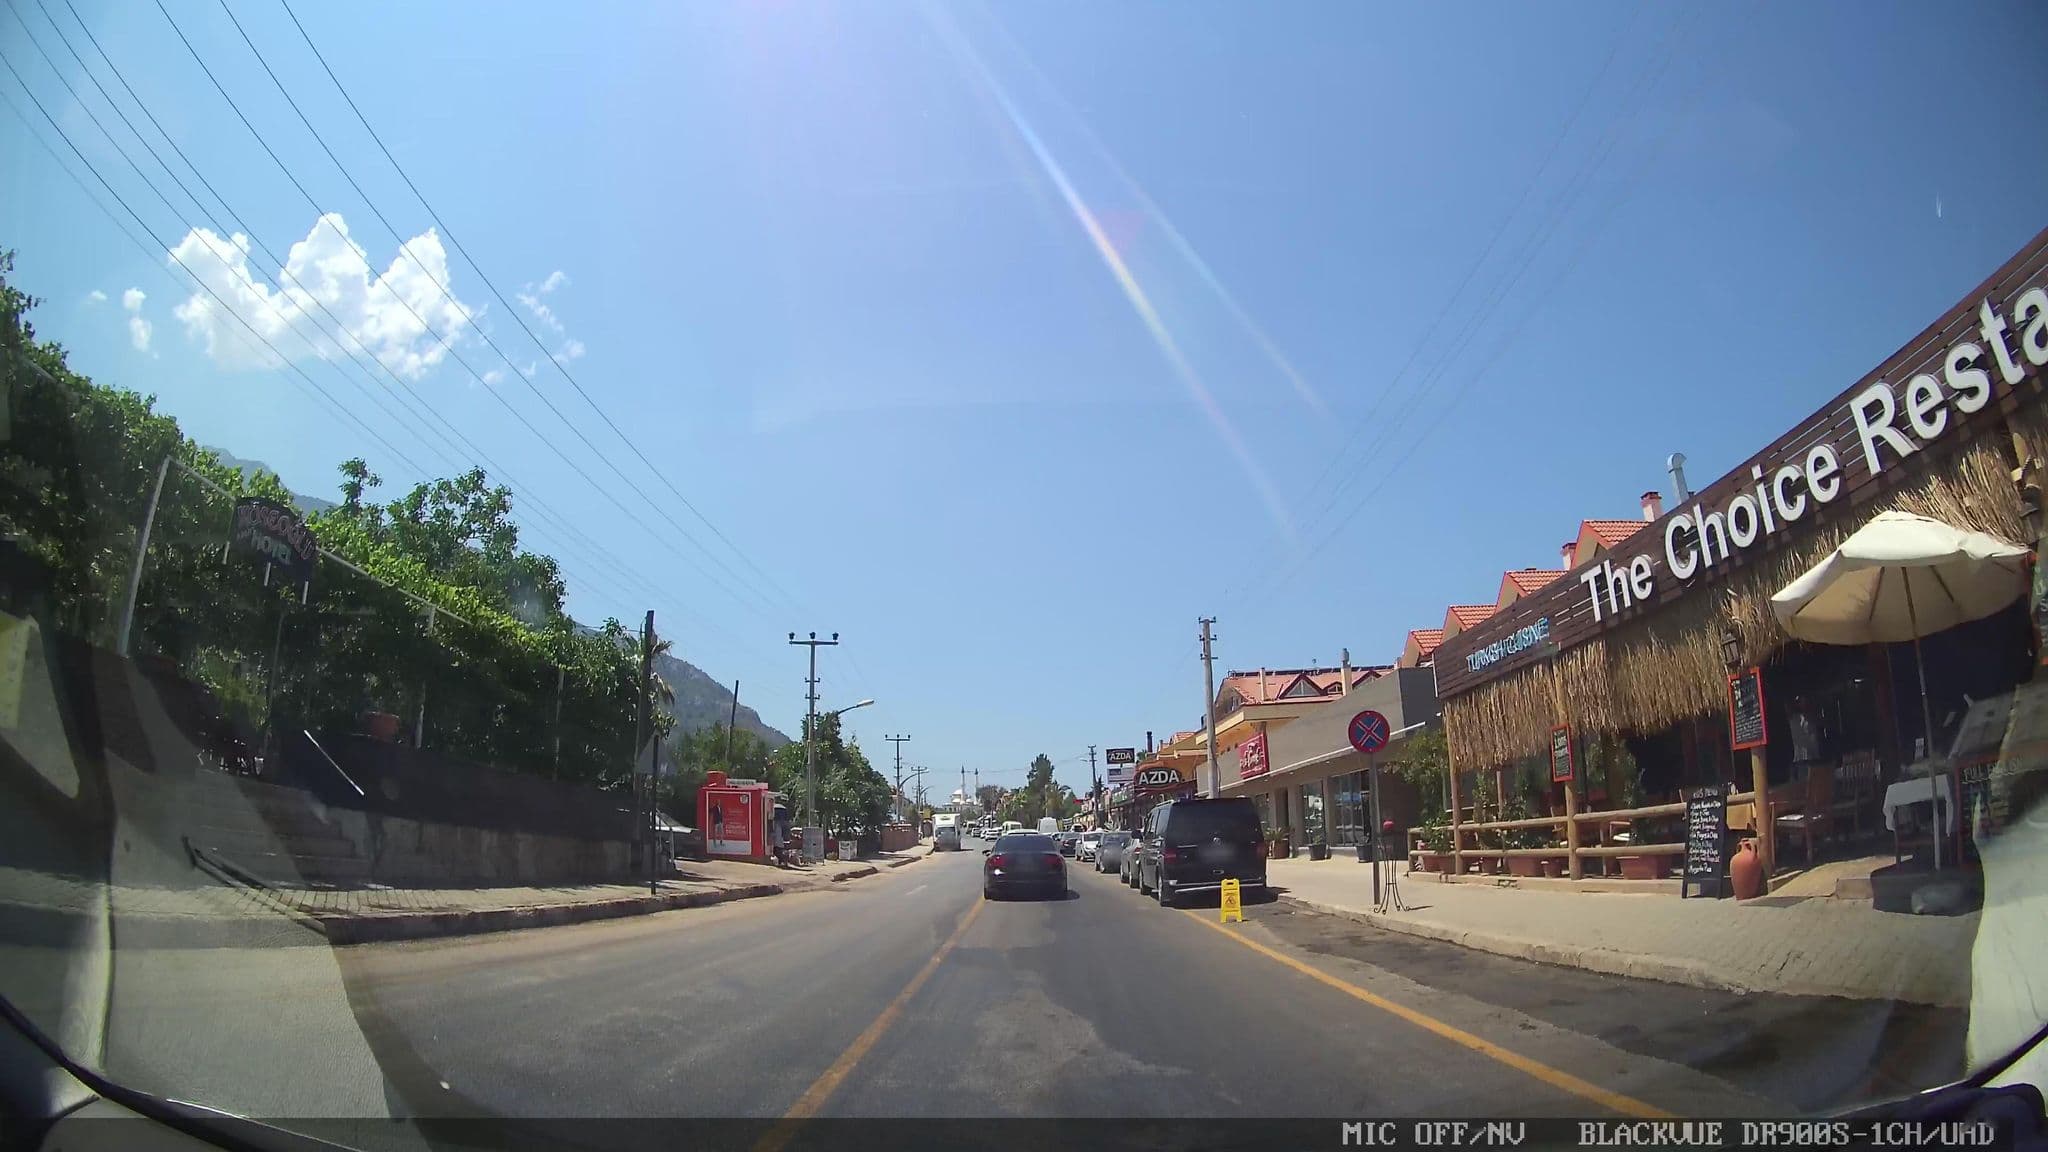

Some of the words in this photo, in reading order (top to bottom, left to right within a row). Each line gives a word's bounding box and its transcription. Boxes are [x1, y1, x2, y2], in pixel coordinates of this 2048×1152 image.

[1580, 554, 1652, 623] The
[1665, 443, 1841, 580] Choice
[1850, 286, 2048, 476] Resta
[1110, 752, 1132, 762] AZDA
[1139, 769, 1180, 785] AZDA
